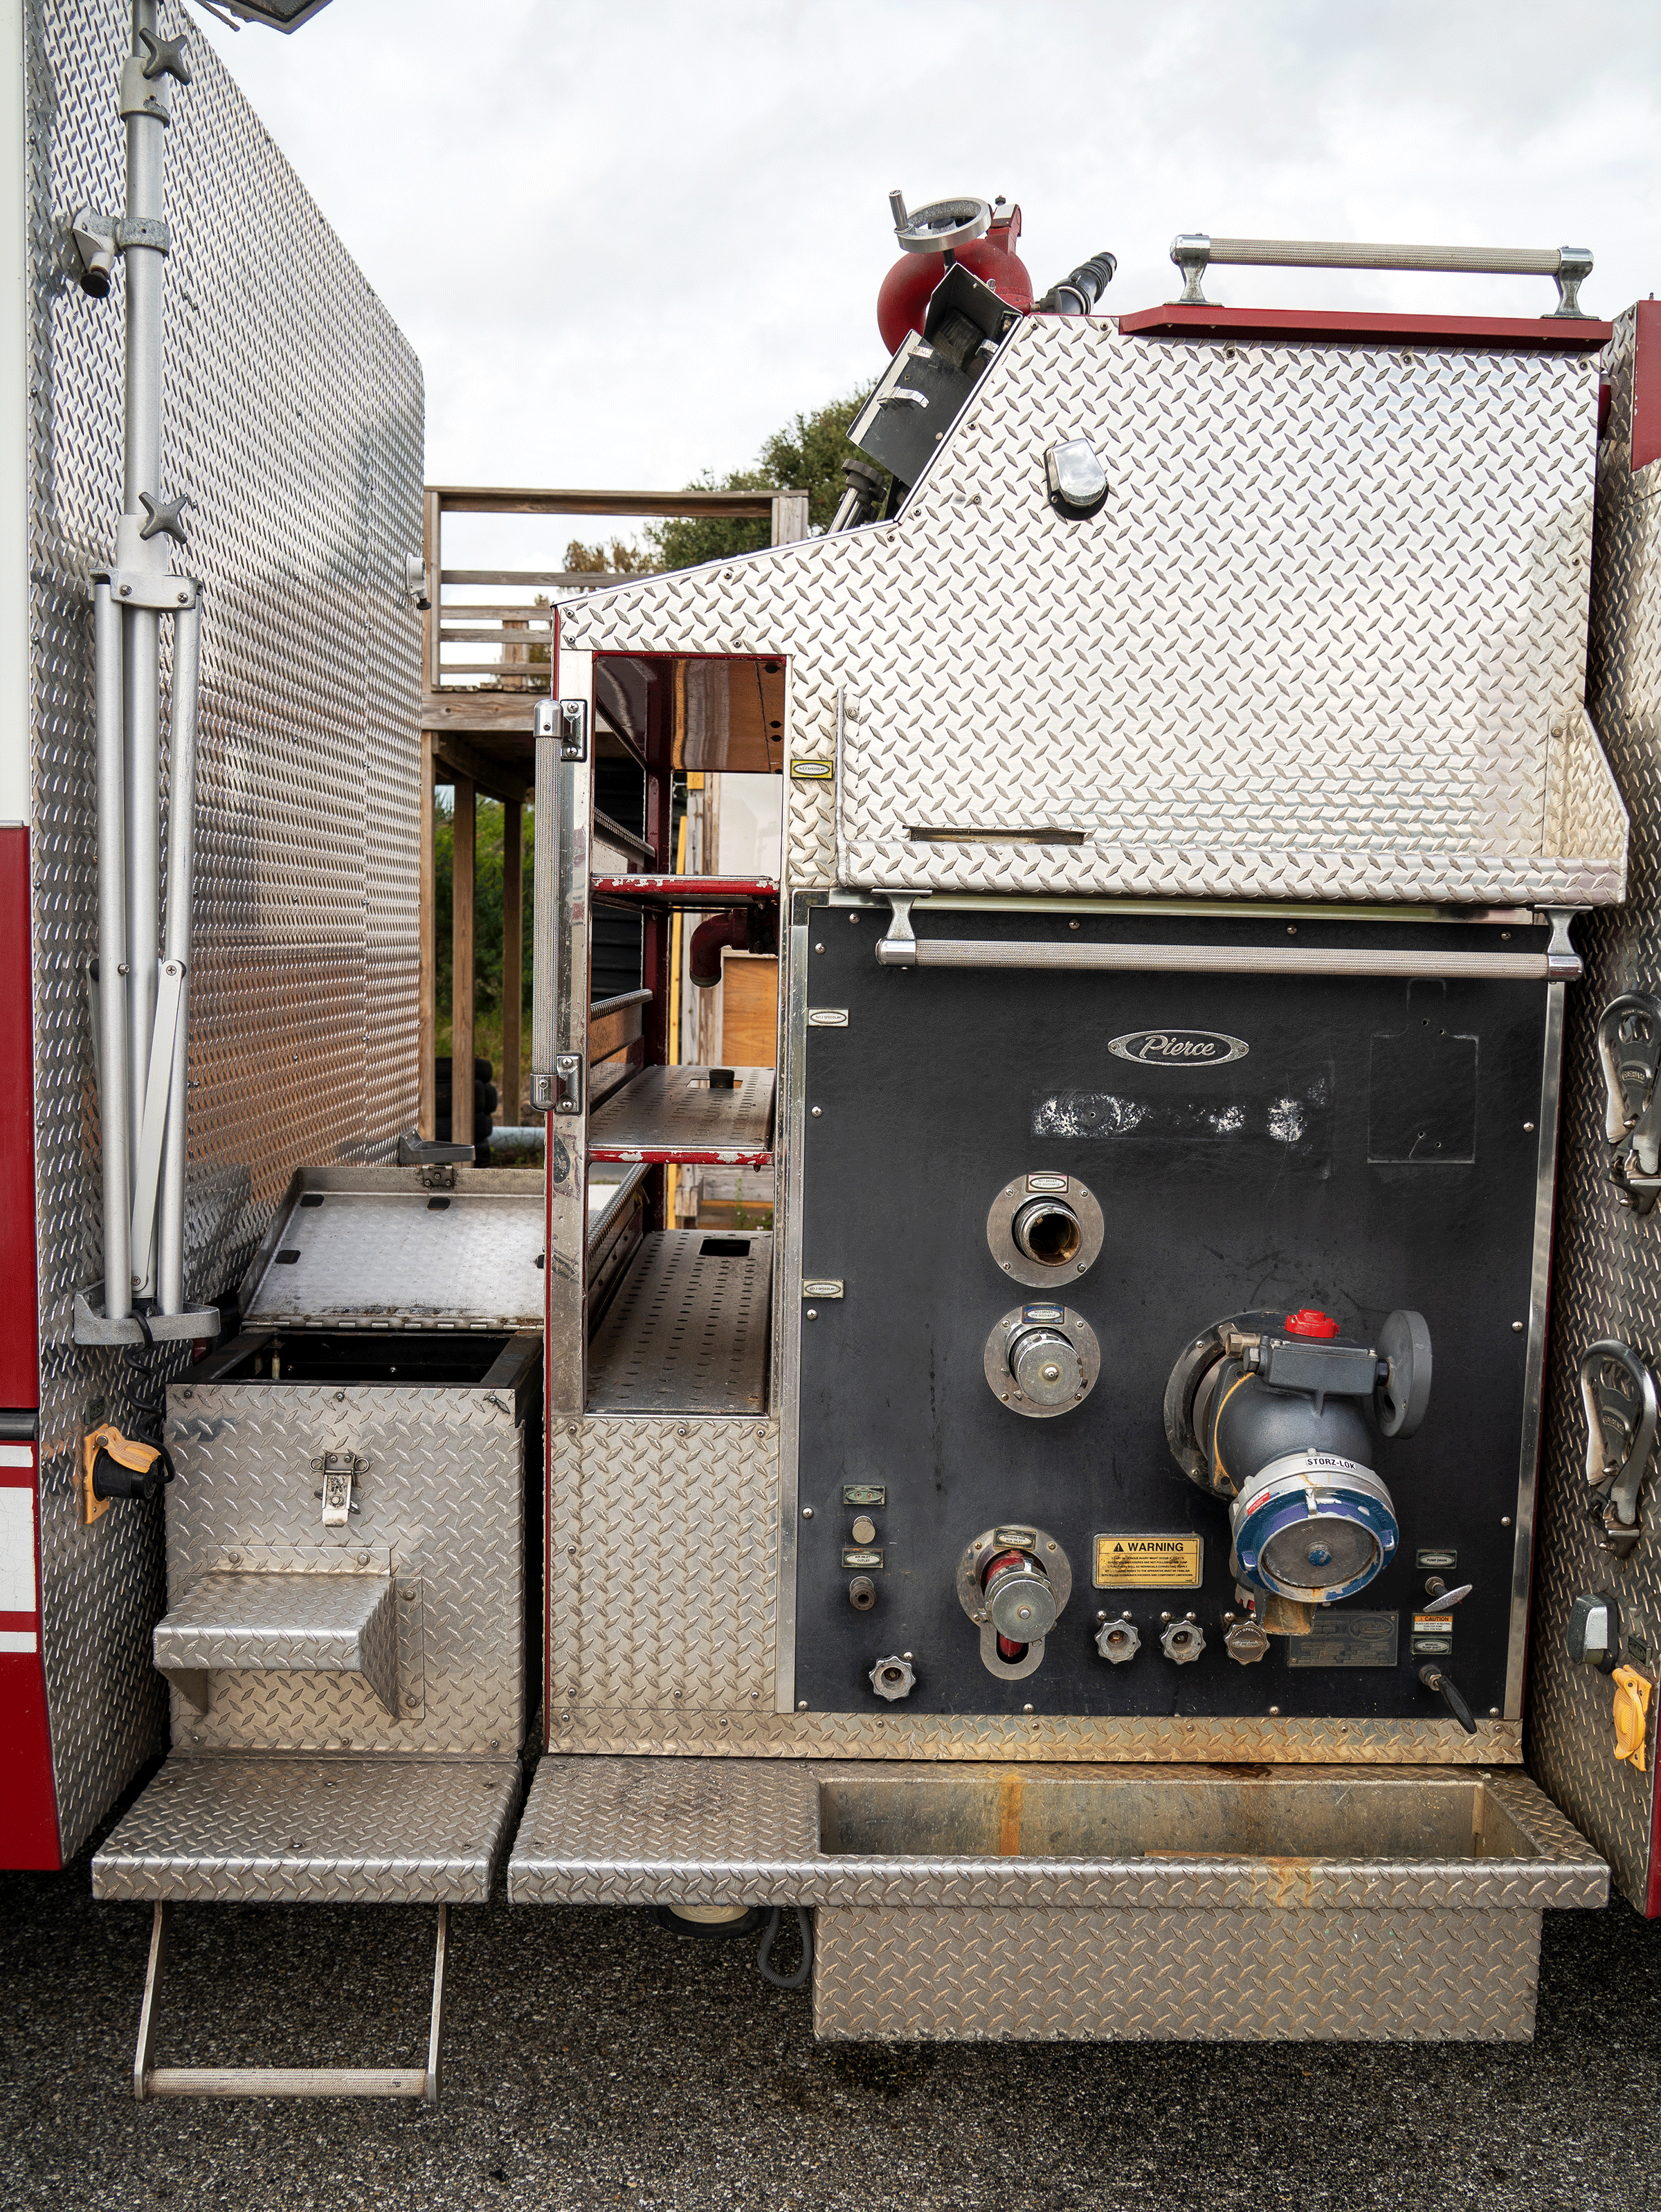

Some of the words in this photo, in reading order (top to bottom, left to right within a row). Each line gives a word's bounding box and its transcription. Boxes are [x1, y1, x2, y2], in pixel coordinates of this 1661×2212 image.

[1138, 1034, 1215, 1059] Pierce
[1307, 1458, 1356, 1470] STORZ-LOK
[1128, 1542, 1183, 1551] WARNING
